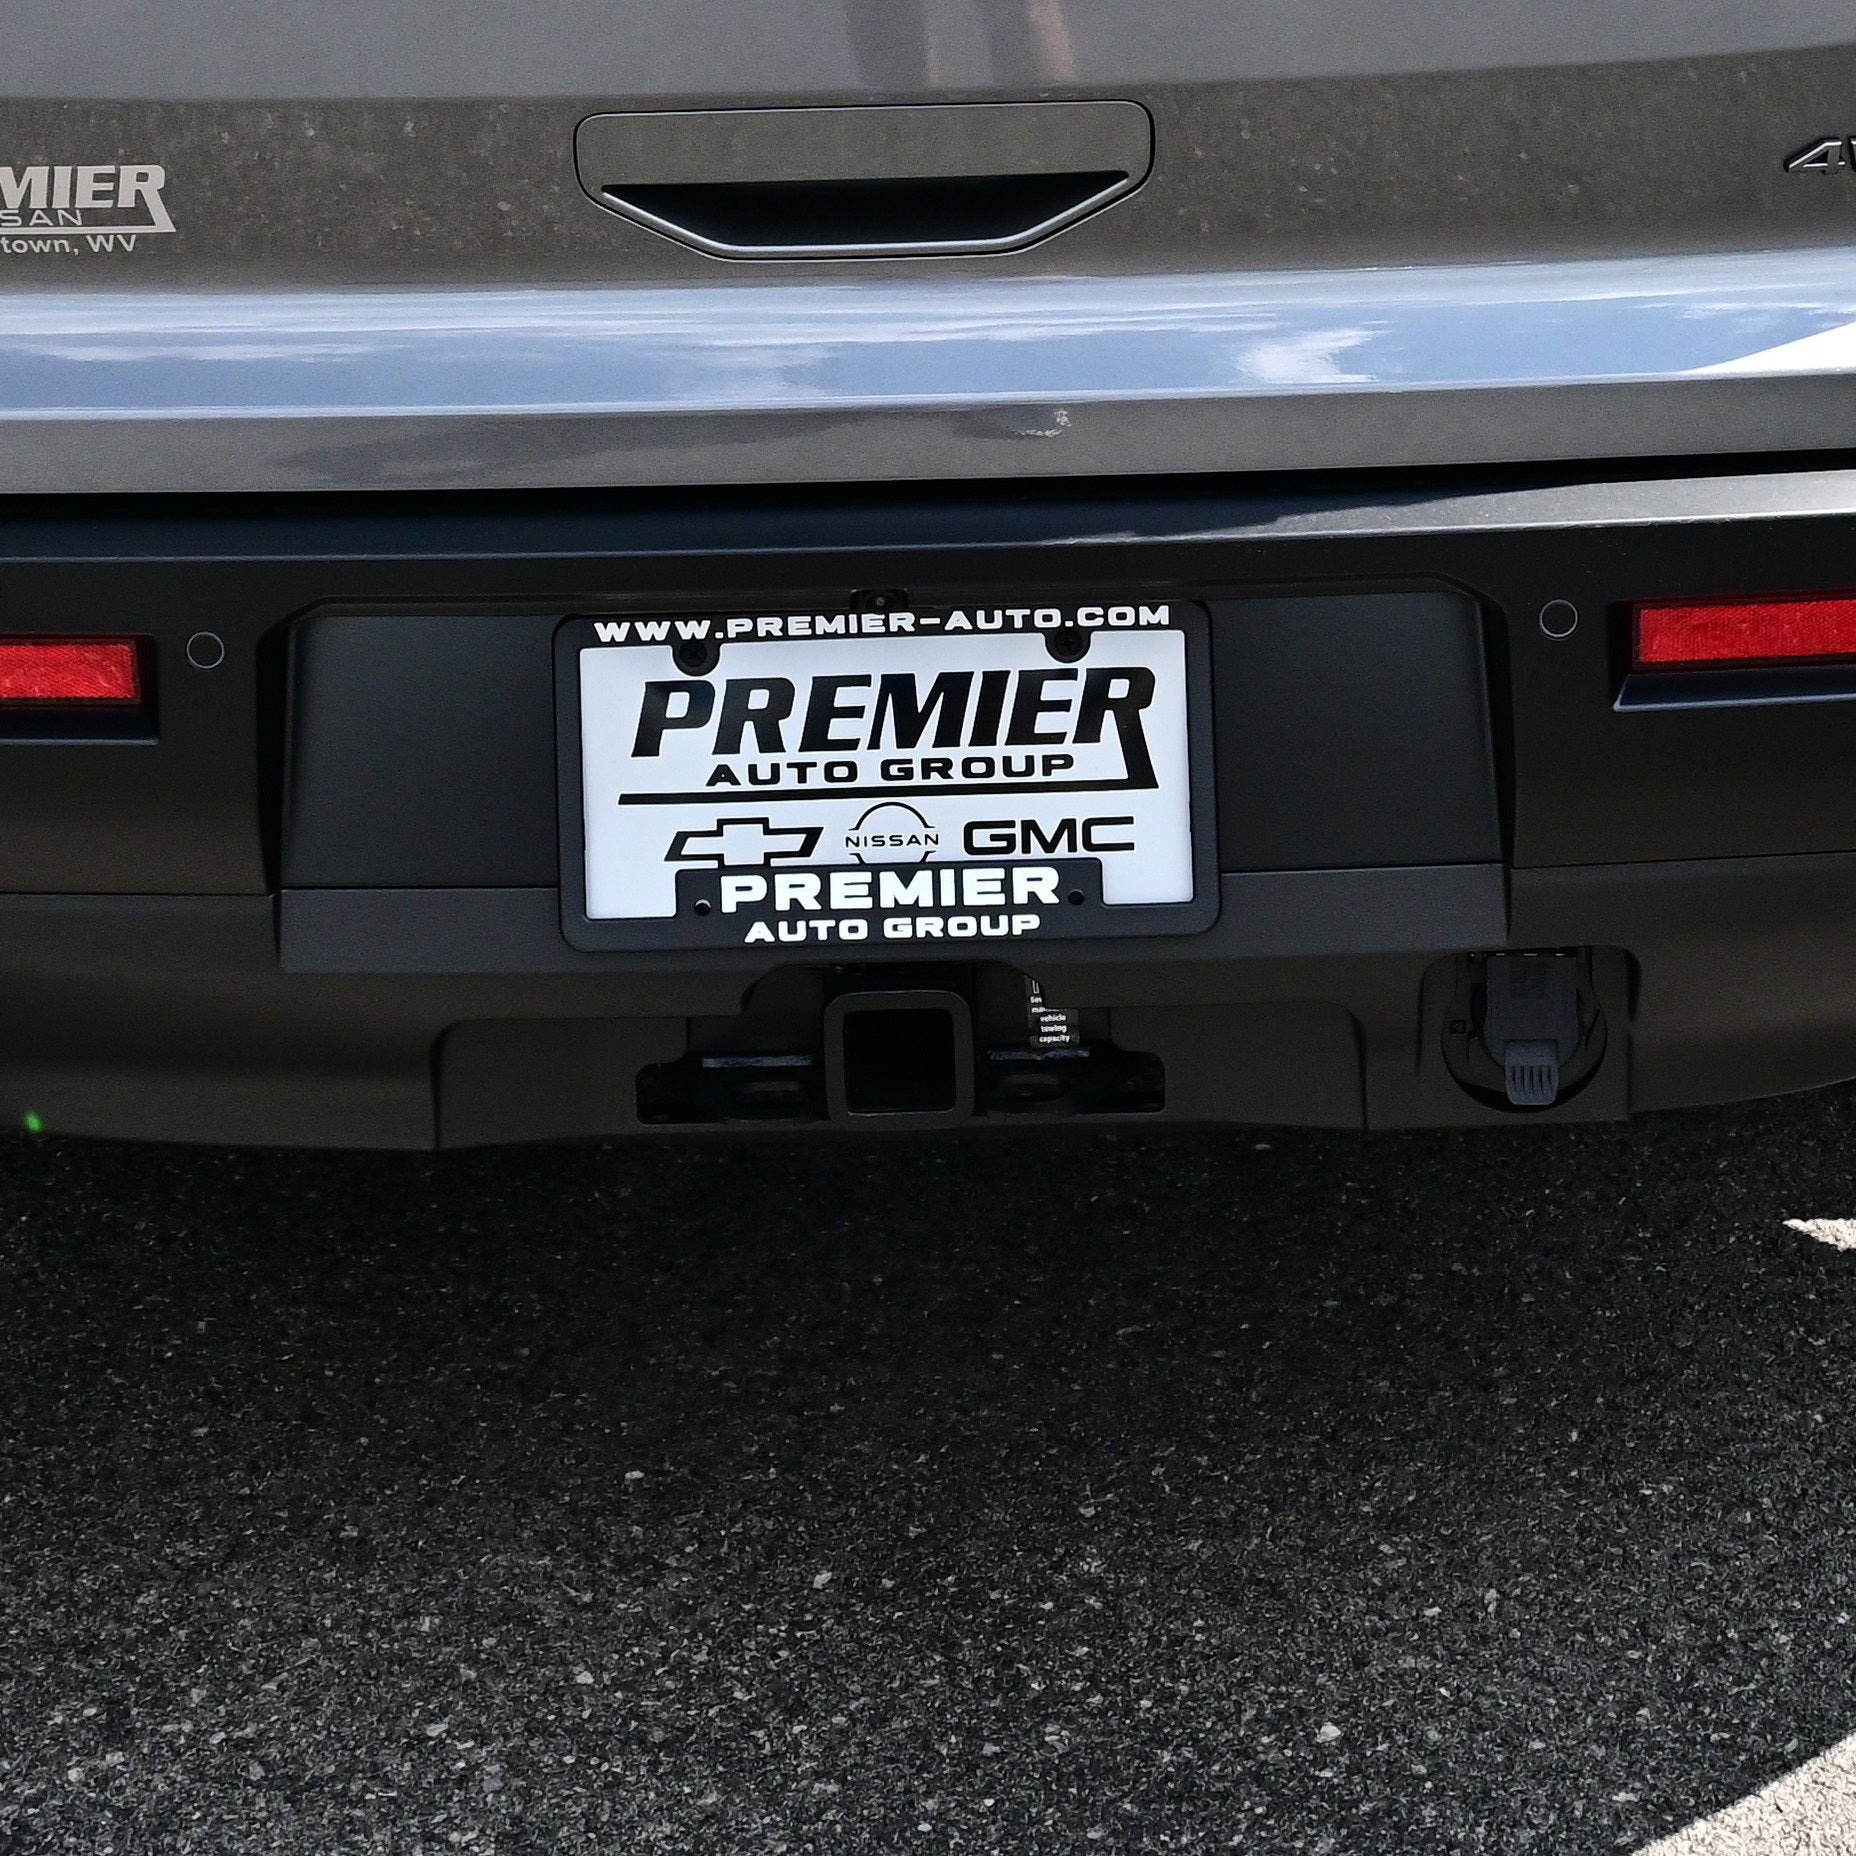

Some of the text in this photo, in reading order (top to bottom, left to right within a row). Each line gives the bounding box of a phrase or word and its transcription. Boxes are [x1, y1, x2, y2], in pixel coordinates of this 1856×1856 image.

[86, 234, 137, 253] WV
[594, 605, 1171, 644] WWW.PREMIER-AUTO.COM
[630, 666, 1158, 789] PREMIER
[705, 754, 1076, 787] AUTO GROUP
[845, 815, 1136, 857] NISSAN GMC
[720, 866, 1061, 914] PREMIER
[744, 913, 1042, 943] AUTO GROUP
